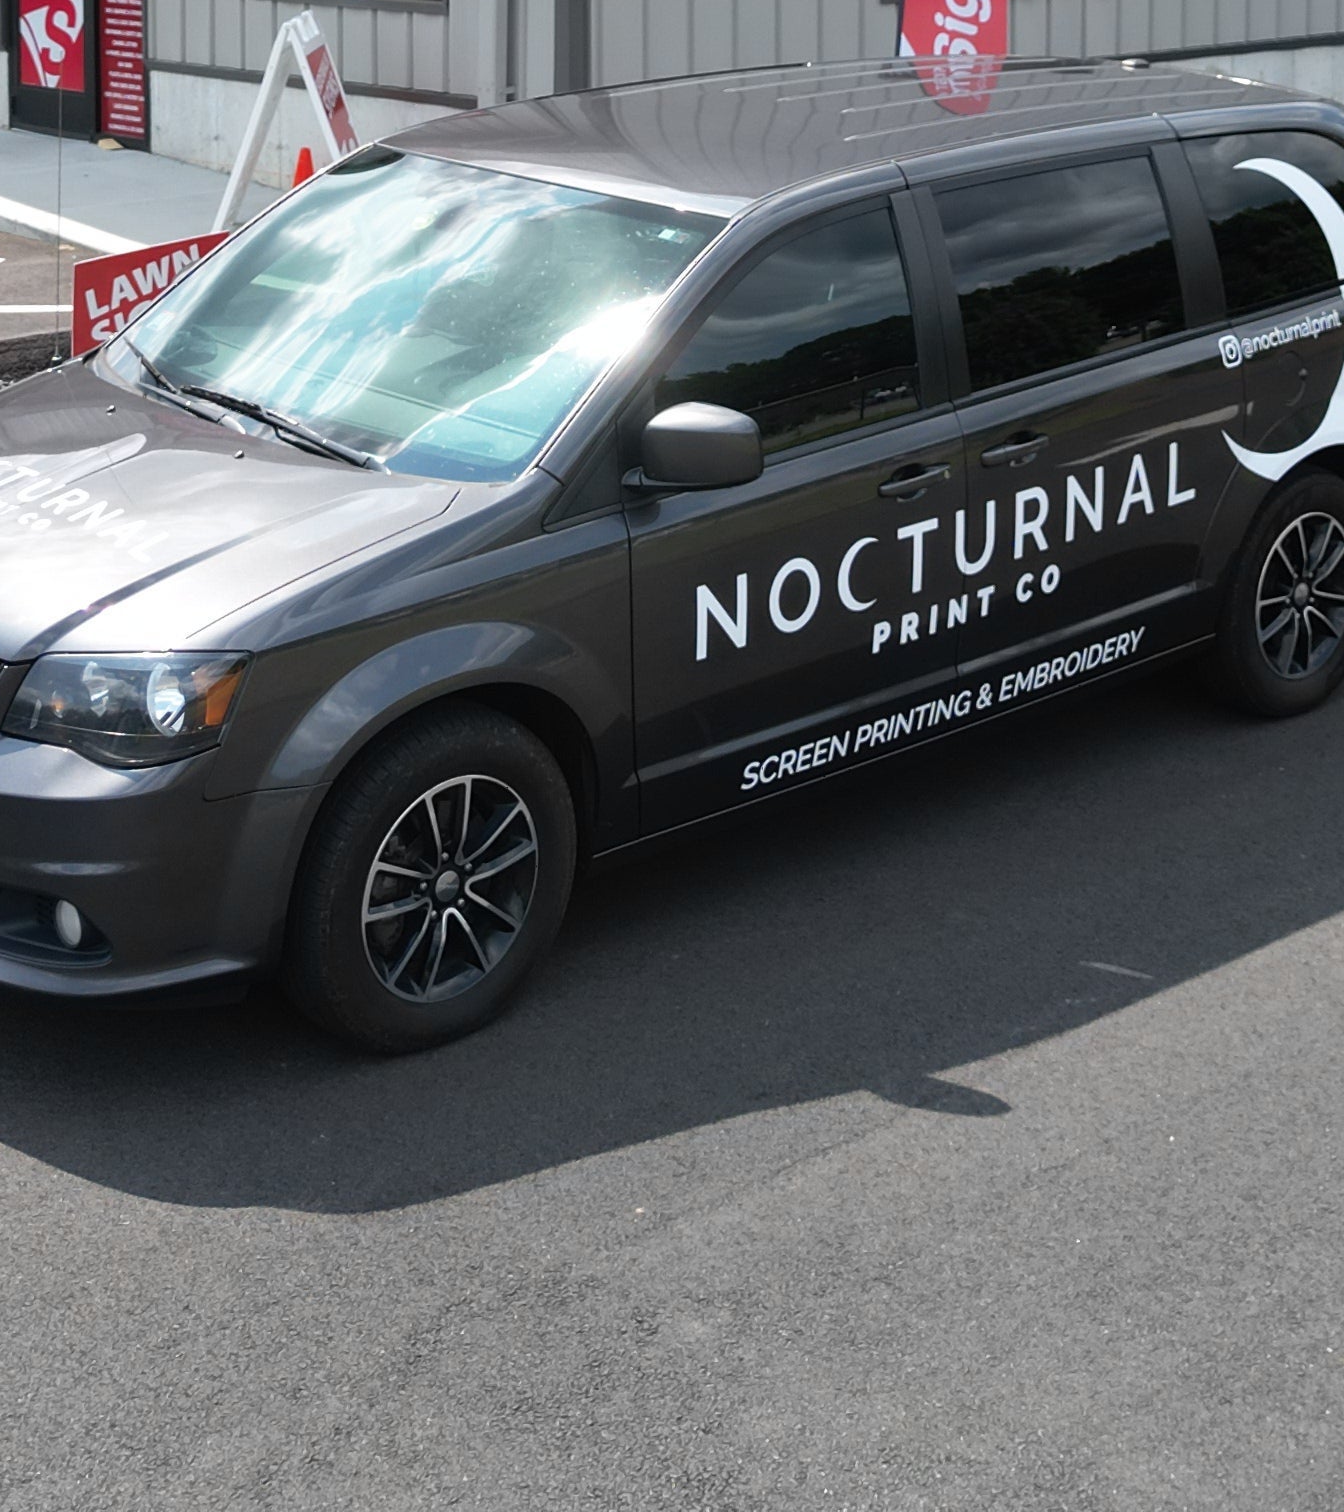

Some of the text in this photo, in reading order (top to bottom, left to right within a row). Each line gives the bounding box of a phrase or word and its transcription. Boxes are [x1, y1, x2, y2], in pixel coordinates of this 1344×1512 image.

[85, 243, 200, 320] LAWN
[1241, 309, 1343, 359] @nocturnalprint
[17, 512, 52, 530] CO
[695, 441, 1197, 661] NOCTURNAL
[871, 564, 1061, 654] PRINT CO
[740, 626, 1146, 790] SCREEN PRINTING & EMBROIDERY
